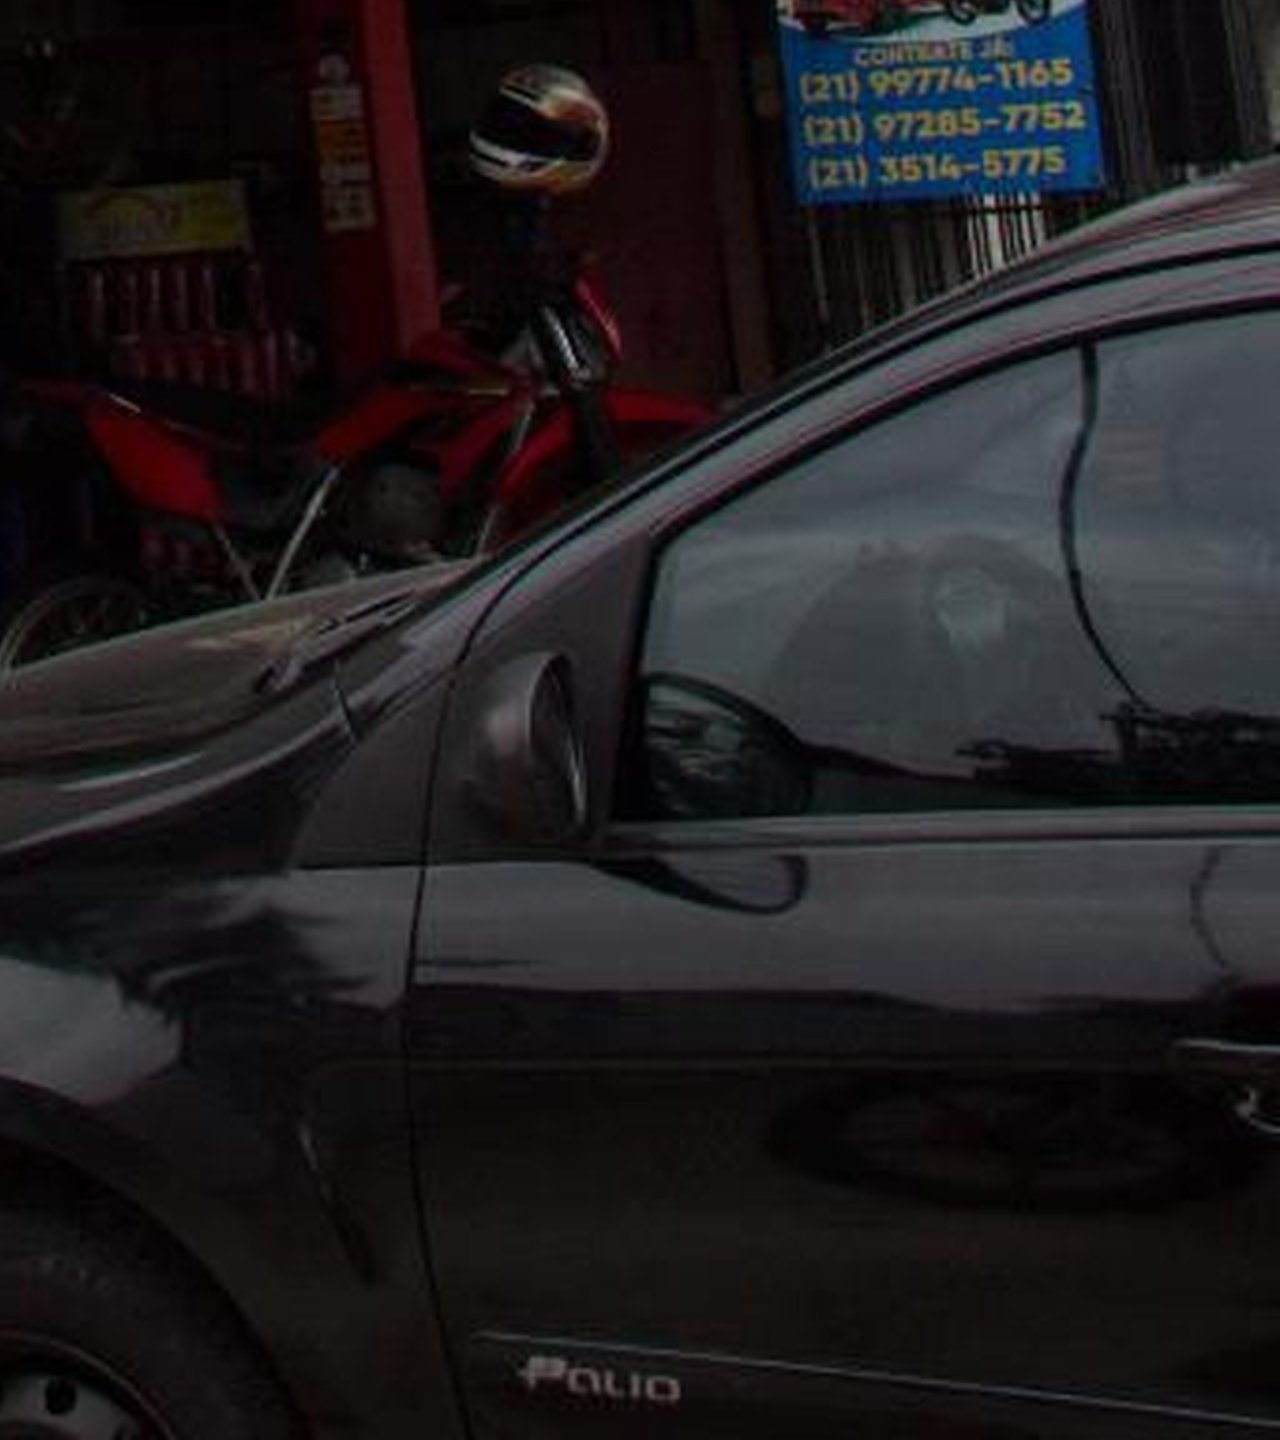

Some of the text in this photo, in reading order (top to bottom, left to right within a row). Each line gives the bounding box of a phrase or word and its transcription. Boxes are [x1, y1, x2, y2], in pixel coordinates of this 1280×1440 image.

[800, 73, 860, 105] (21)
[804, 114, 865, 147] (21)
[810, 156, 870, 190] (21)
